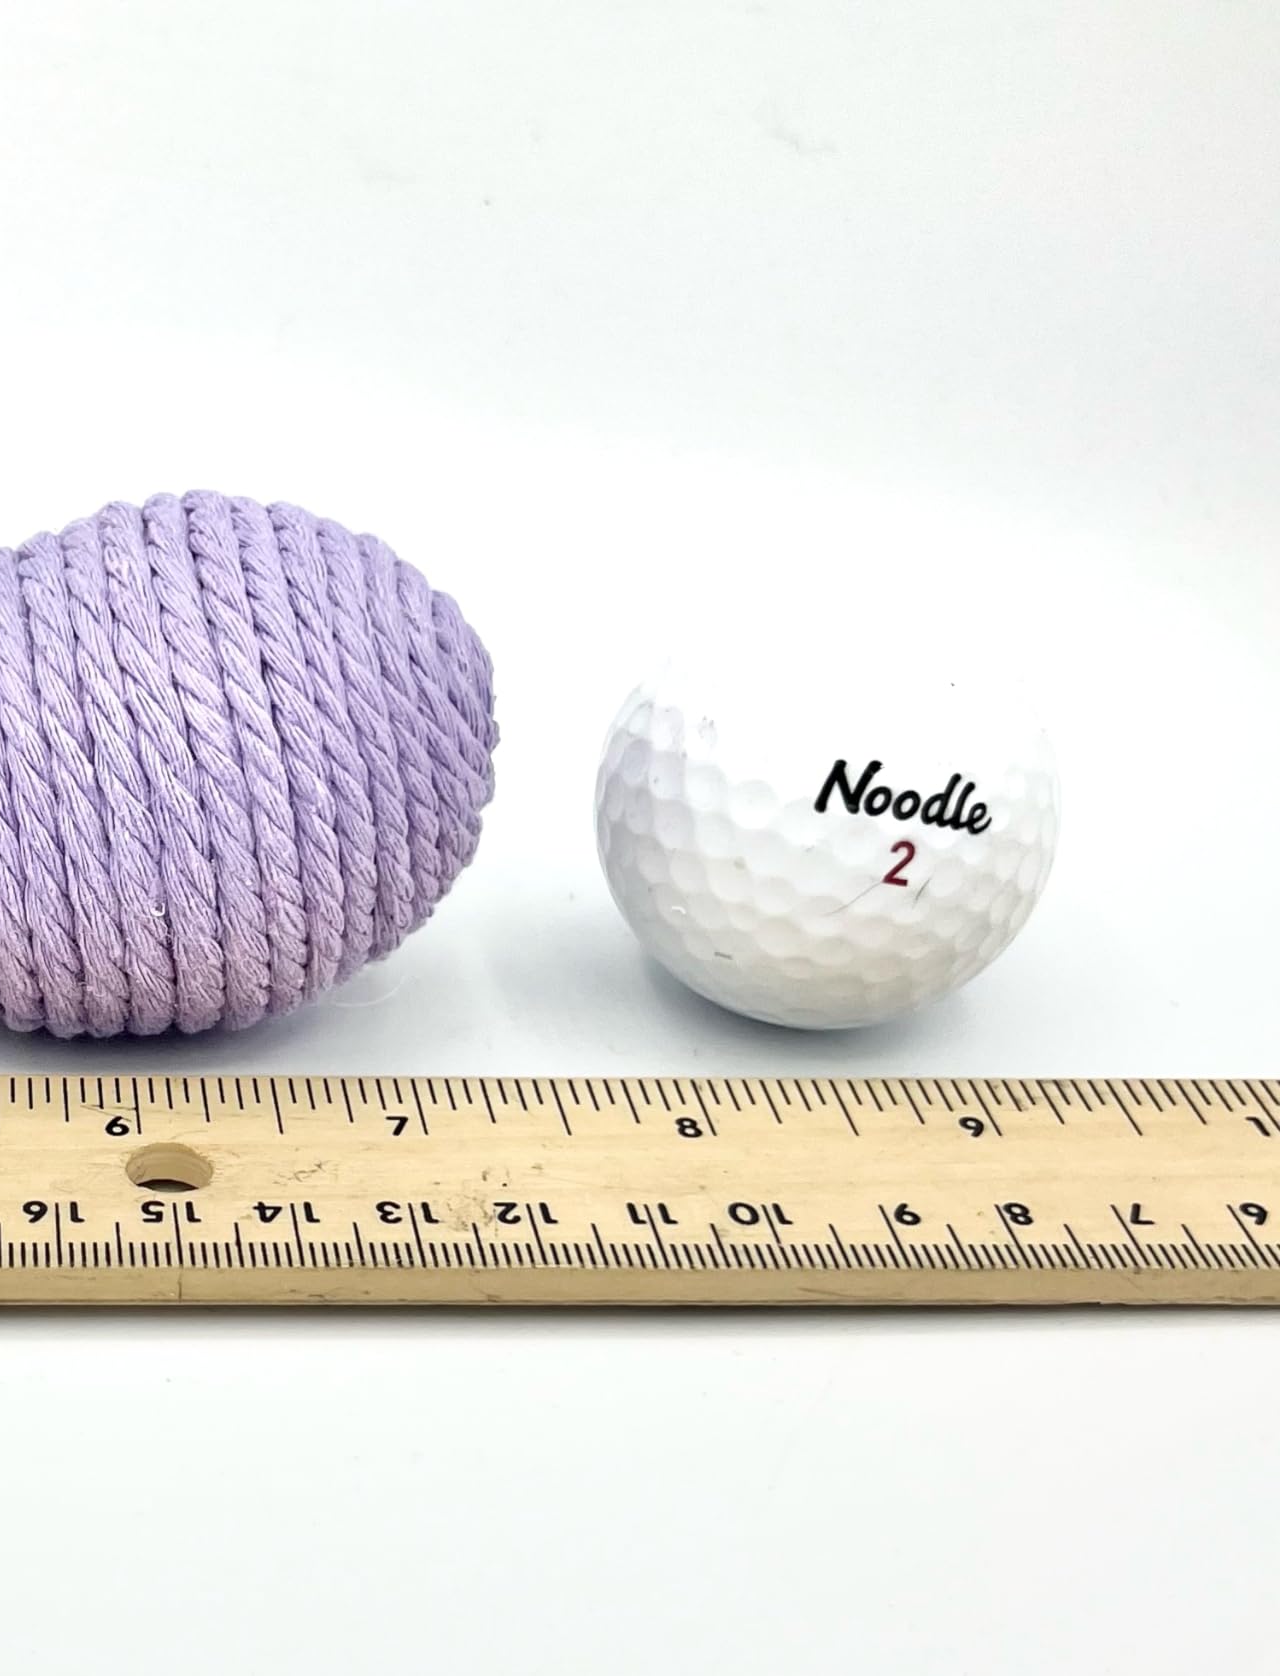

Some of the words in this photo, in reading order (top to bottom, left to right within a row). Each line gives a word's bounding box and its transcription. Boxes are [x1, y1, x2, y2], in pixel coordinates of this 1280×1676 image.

[813, 759, 993, 836] Noodle
[882, 840, 916, 887] 2
[105, 1115, 130, 1137] 6
[385, 1116, 409, 1137] 7
[675, 1117, 703, 1138] 8
[959, 1116, 985, 1138] 9
[22, 1200, 85, 1224] 16
[141, 1200, 202, 1223] 15
[252, 1201, 321, 1224] 14
[375, 1201, 440, 1224] 13
[493, 1202, 558, 1225] 12
[626, 1202, 678, 1225] 11
[728, 1202, 793, 1226] 10
[894, 1203, 921, 1226] 9
[1002, 1202, 1034, 1226] 8
[1130, 1203, 1155, 1226] 7
[1239, 1202, 1268, 1226] 6
